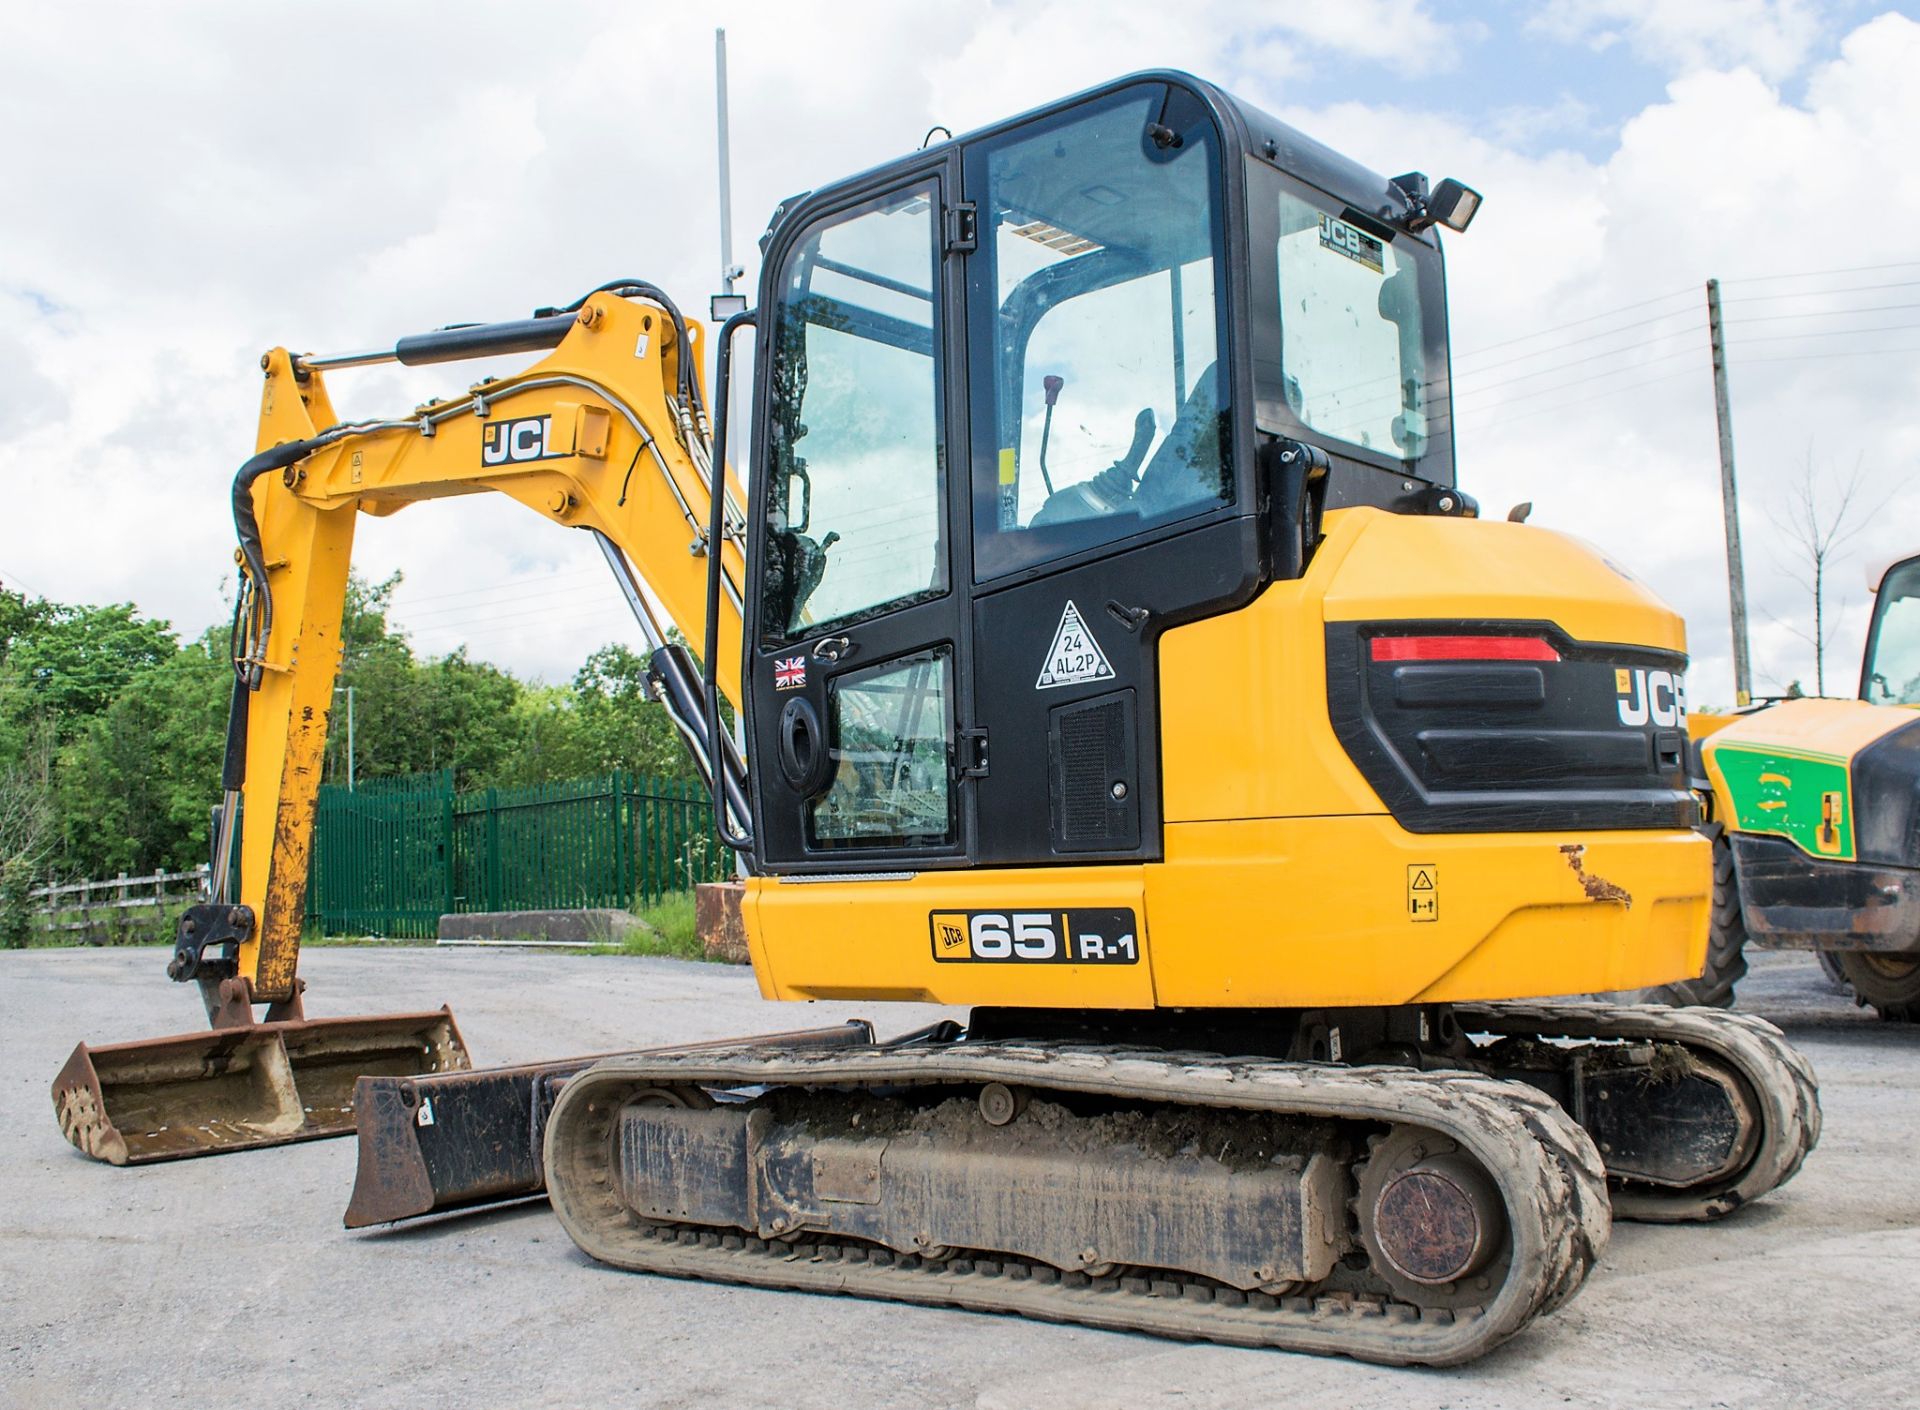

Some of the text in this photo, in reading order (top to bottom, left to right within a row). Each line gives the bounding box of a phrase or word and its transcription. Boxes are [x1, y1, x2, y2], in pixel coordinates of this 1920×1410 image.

[1319, 216, 1360, 254] JCB
[1064, 633, 1082, 652] 24
[1056, 653, 1095, 675] AL2P
[943, 913, 1136, 960] JCB 65 R-1
